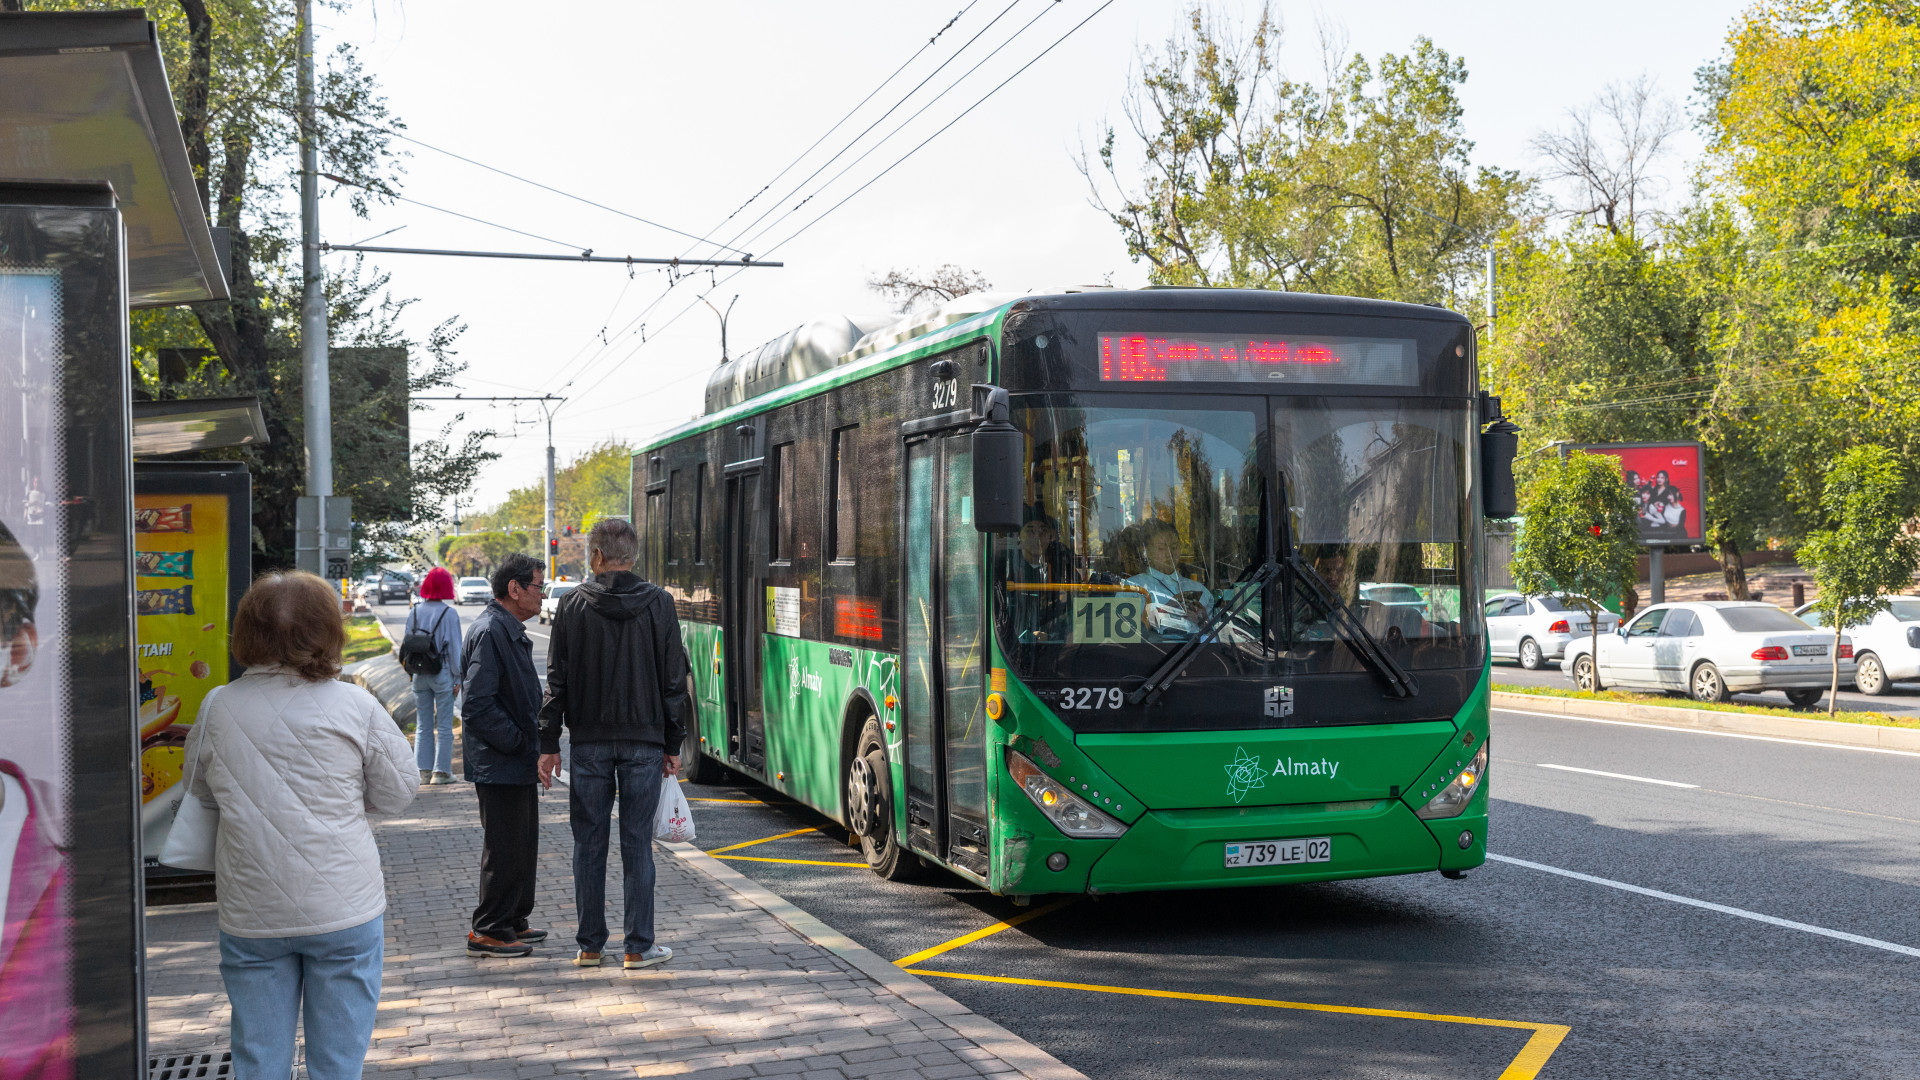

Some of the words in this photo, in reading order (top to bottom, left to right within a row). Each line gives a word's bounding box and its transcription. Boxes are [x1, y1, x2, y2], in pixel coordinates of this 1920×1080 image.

[932, 378, 957, 409] 3279
[1077, 602, 1138, 639] 118
[802, 666, 822, 698] Almaty
[1060, 687, 1124, 710] 3279
[1272, 757, 1339, 779] Almaty
[1226, 856, 1240, 865] KZ
[1244, 844, 1277, 864] 739
[1282, 847, 1301, 862] LE
[1308, 841, 1329, 859] 02
